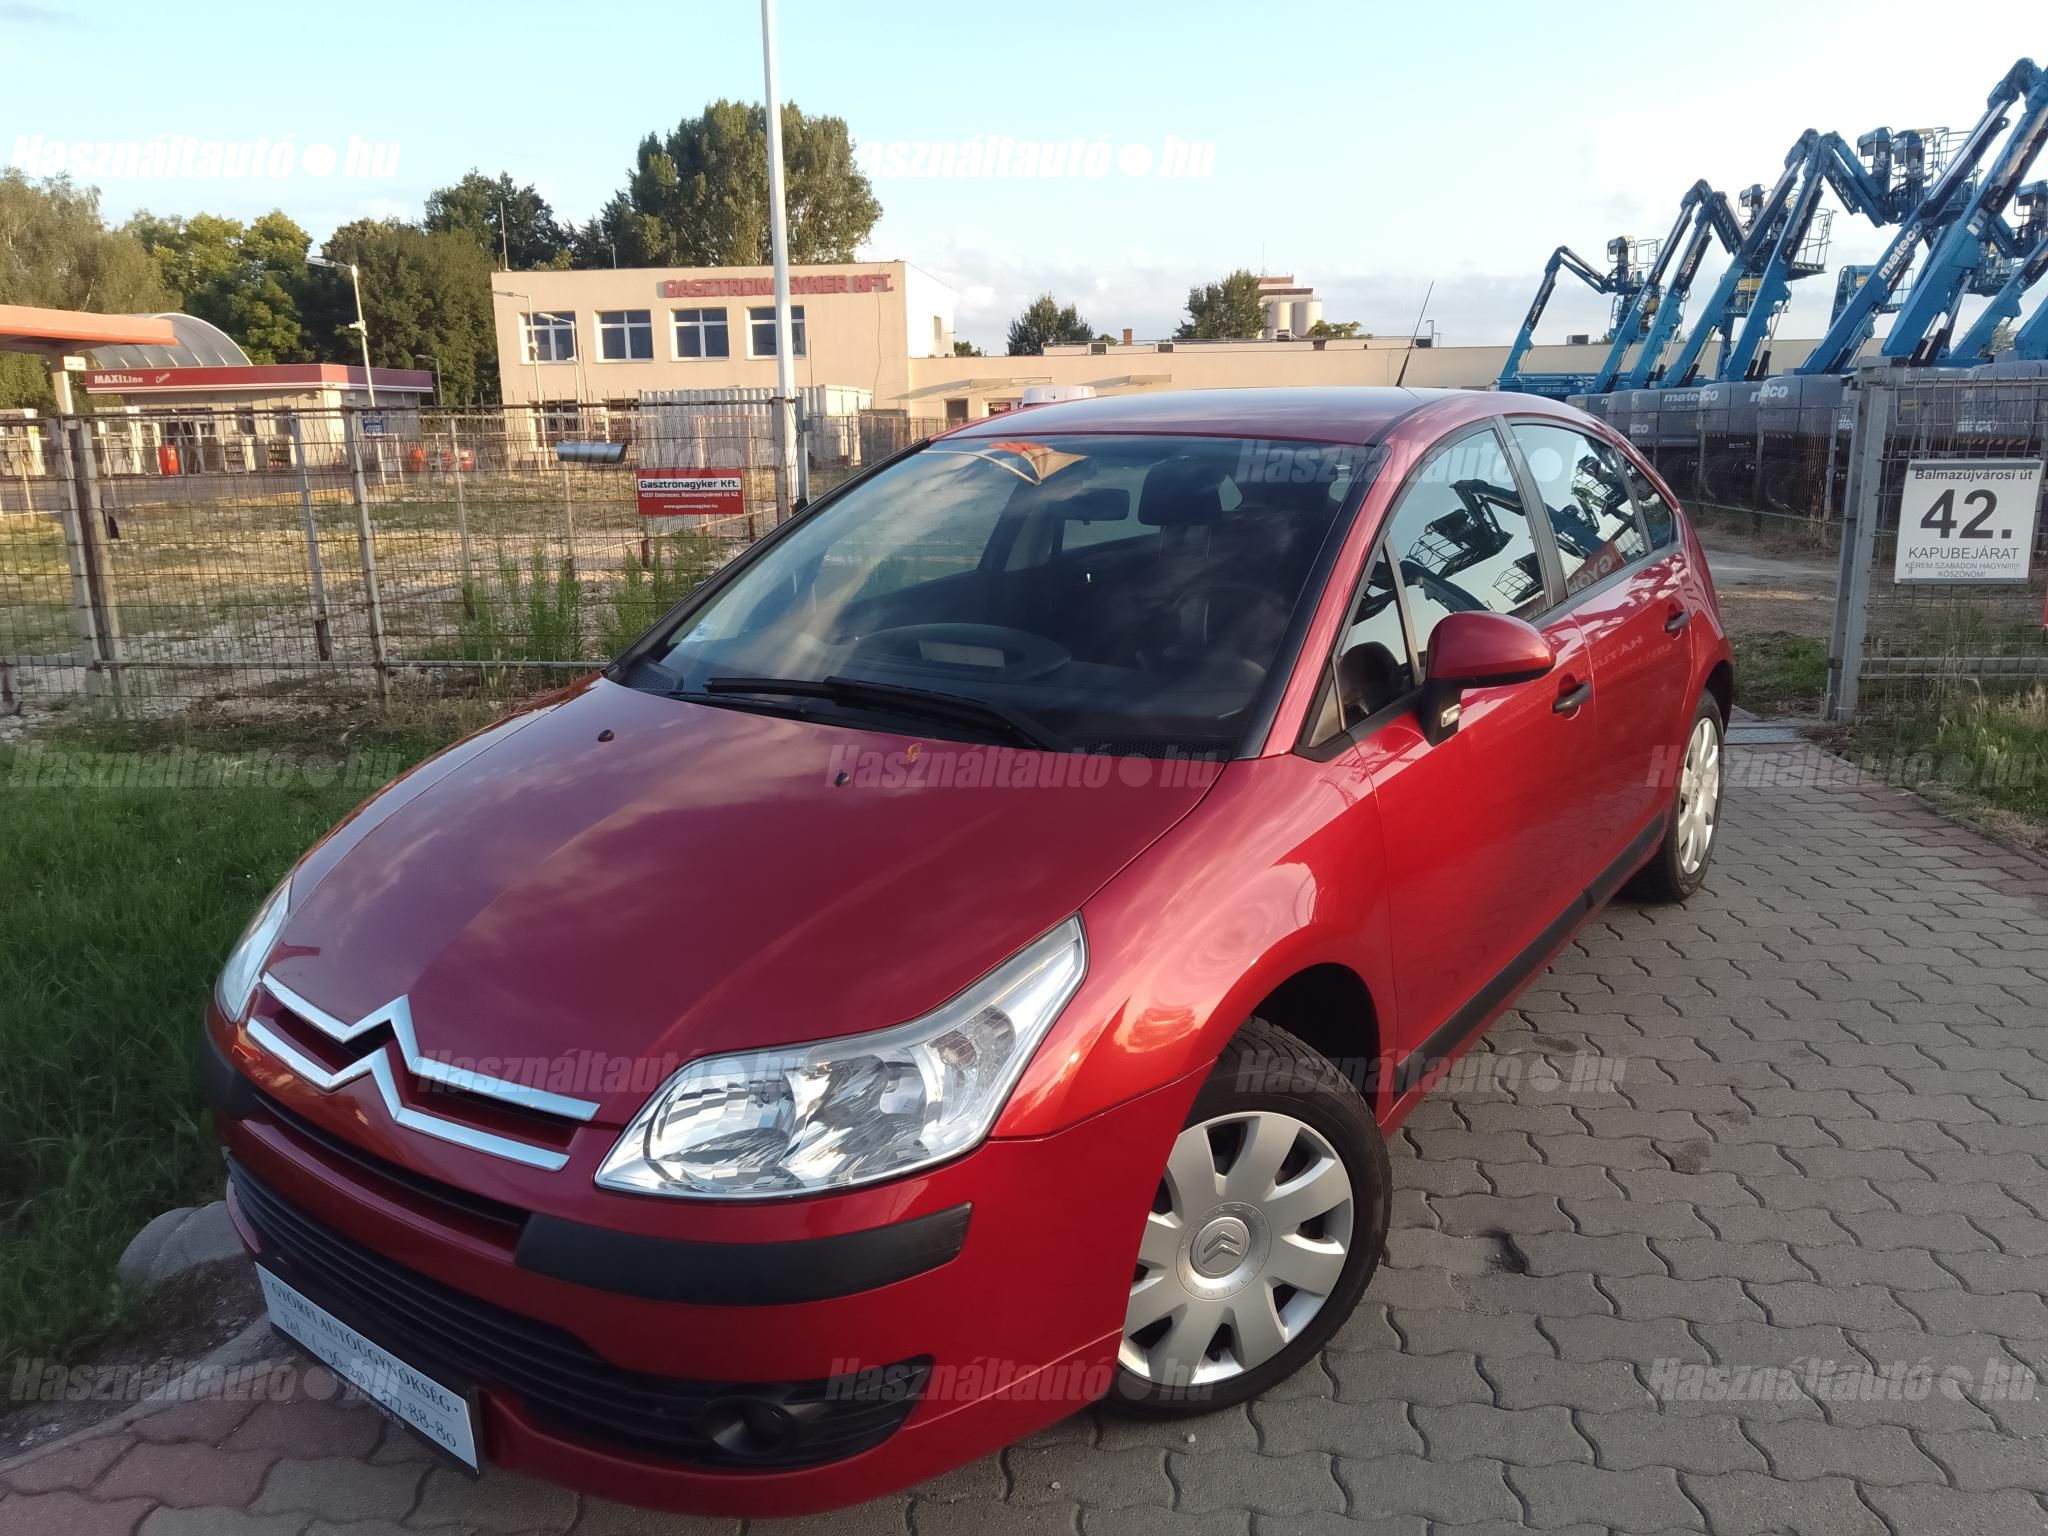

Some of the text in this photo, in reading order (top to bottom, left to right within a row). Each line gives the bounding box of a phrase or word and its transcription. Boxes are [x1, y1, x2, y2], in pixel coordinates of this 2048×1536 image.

[1877, 221, 1924, 280] mateco
[1915, 469, 2033, 482] Balmazújvárosi út
[640, 479, 740, 490] Gasztronagyker Kft.
[1920, 489, 2012, 539] 42.
[1908, 545, 2020, 560] KAPUBEJÁRAT
